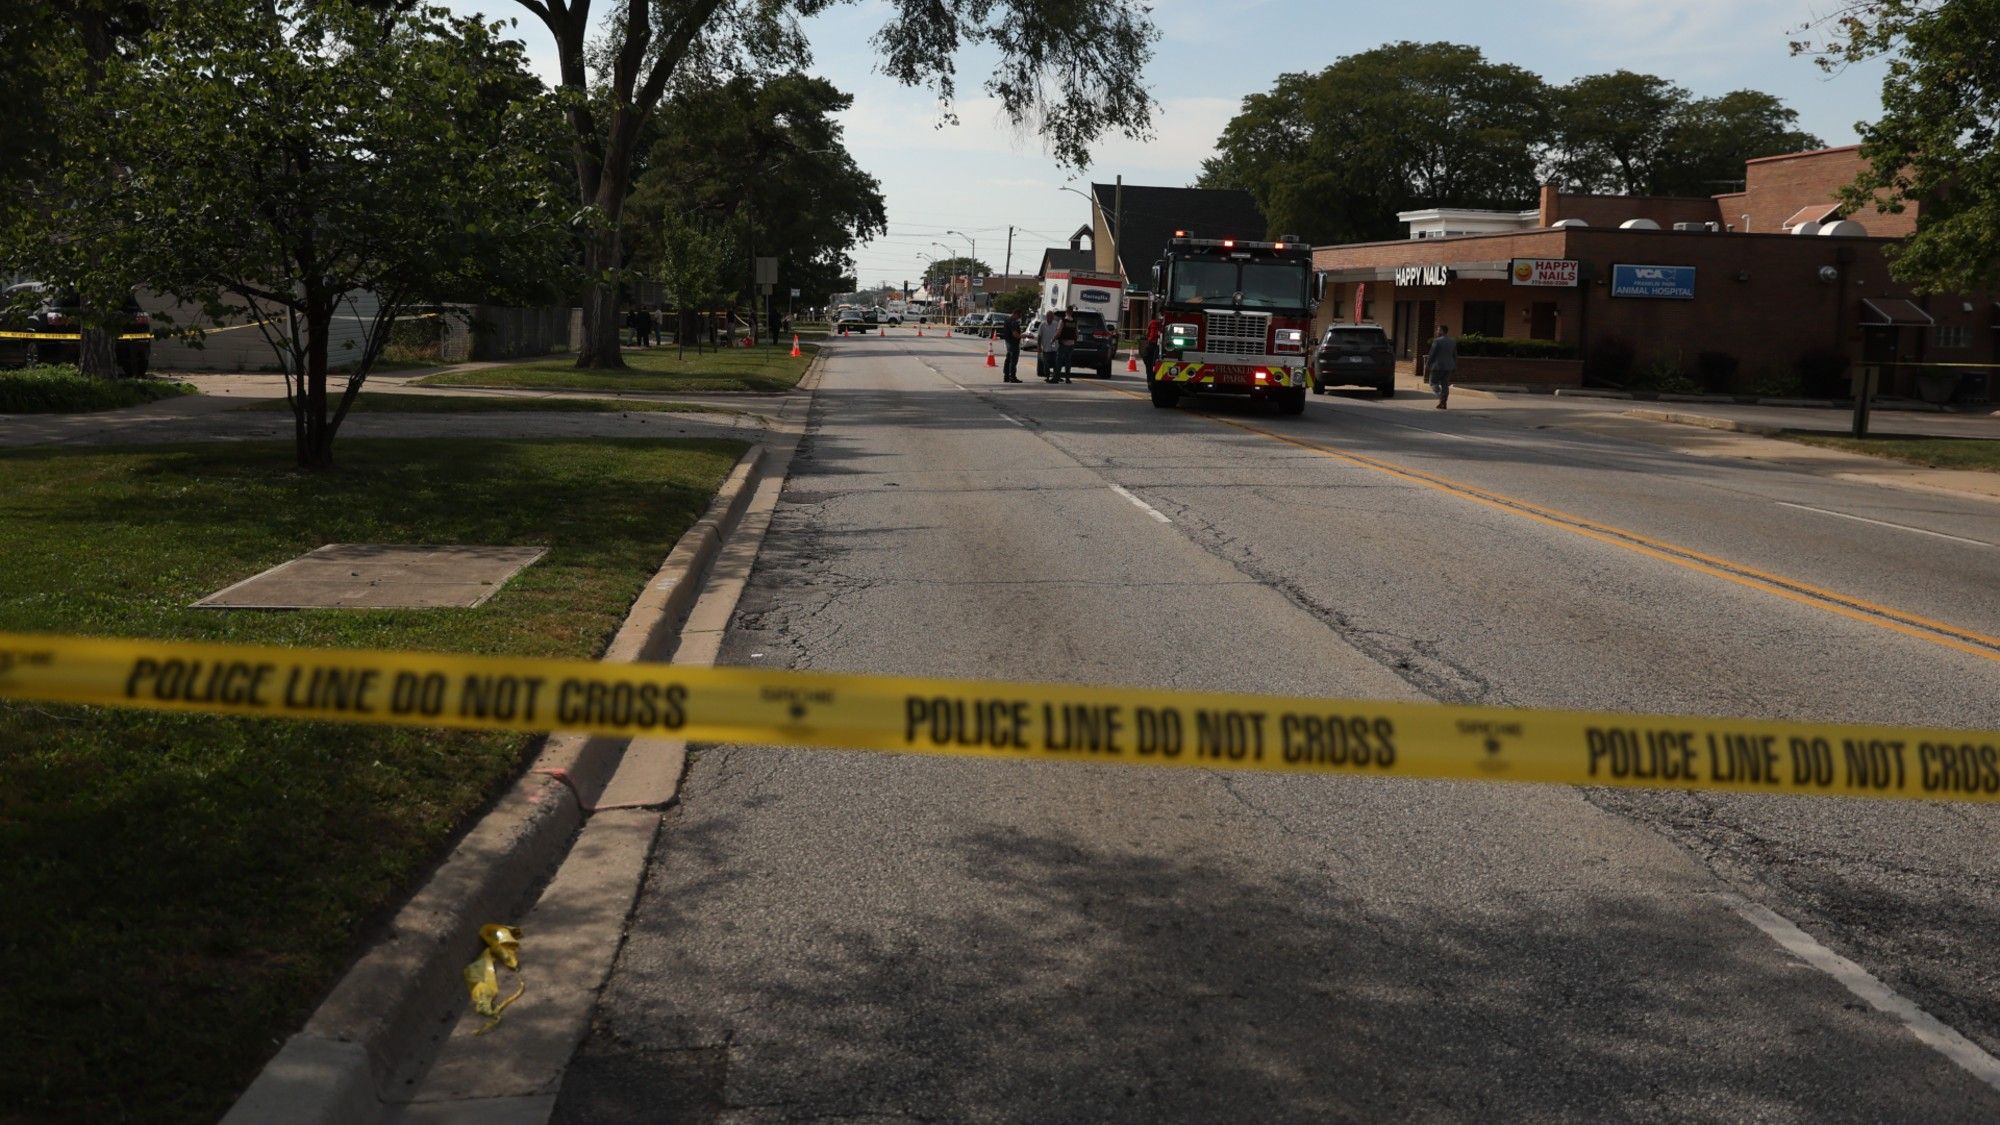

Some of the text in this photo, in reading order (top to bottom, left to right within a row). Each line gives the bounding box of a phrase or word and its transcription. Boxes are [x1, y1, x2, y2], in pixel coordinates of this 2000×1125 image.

[1535, 261, 1577, 271] HAPPY
[1635, 268, 1663, 278] VCA
[1395, 265, 1447, 286] HAPPY NAILS
[1538, 271, 1576, 281] NAILS
[1616, 287, 1693, 296] ANIMAL HOSPITAL
[125, 658, 691, 731] POLICE LINE DO NOT CROSS
[904, 696, 1398, 769] POLICE LINE DO NOT CROSS
[1585, 727, 1698, 782] POLICE
[1707, 733, 1780, 785] LINE
[1789, 737, 1834, 788] DO
[1842, 740, 1907, 791] NOT
